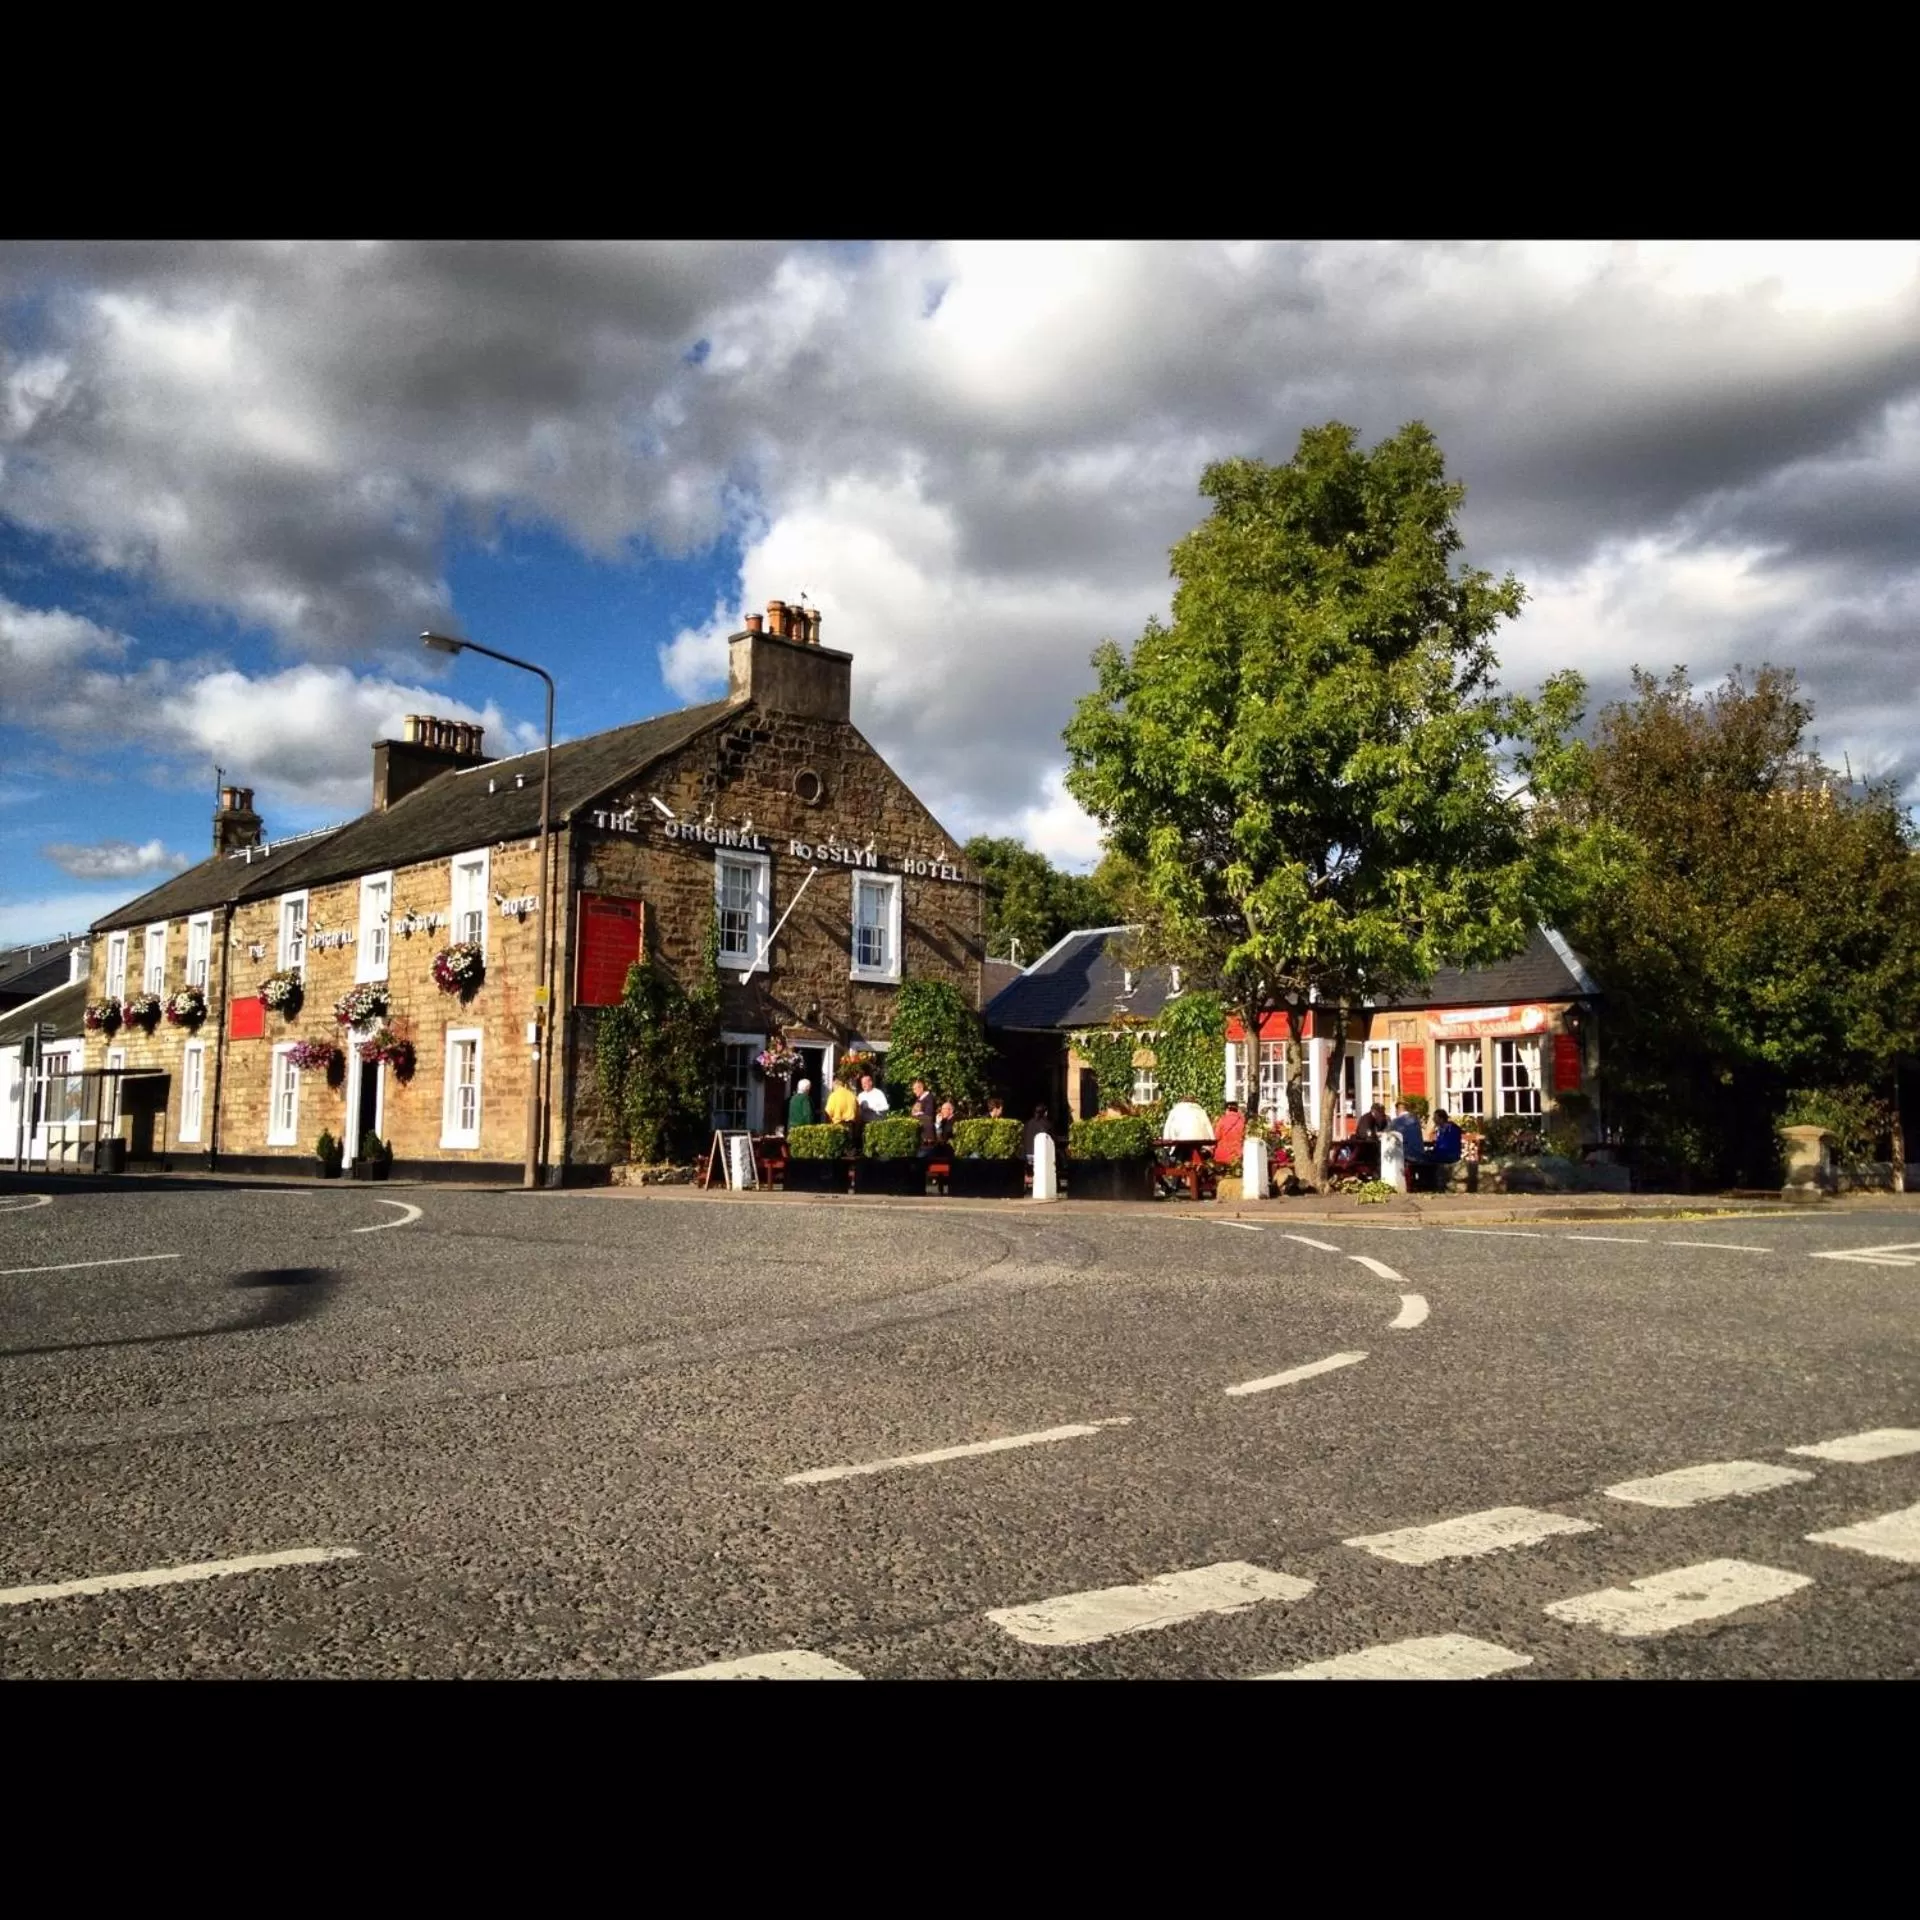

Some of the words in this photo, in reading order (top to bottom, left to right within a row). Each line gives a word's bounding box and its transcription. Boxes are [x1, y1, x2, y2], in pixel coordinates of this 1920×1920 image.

[593, 809, 639, 833] THE
[664, 820, 766, 851] ORIGINAL
[790, 839, 878, 868] ROSSLYN
[904, 858, 963, 881] HOTEL
